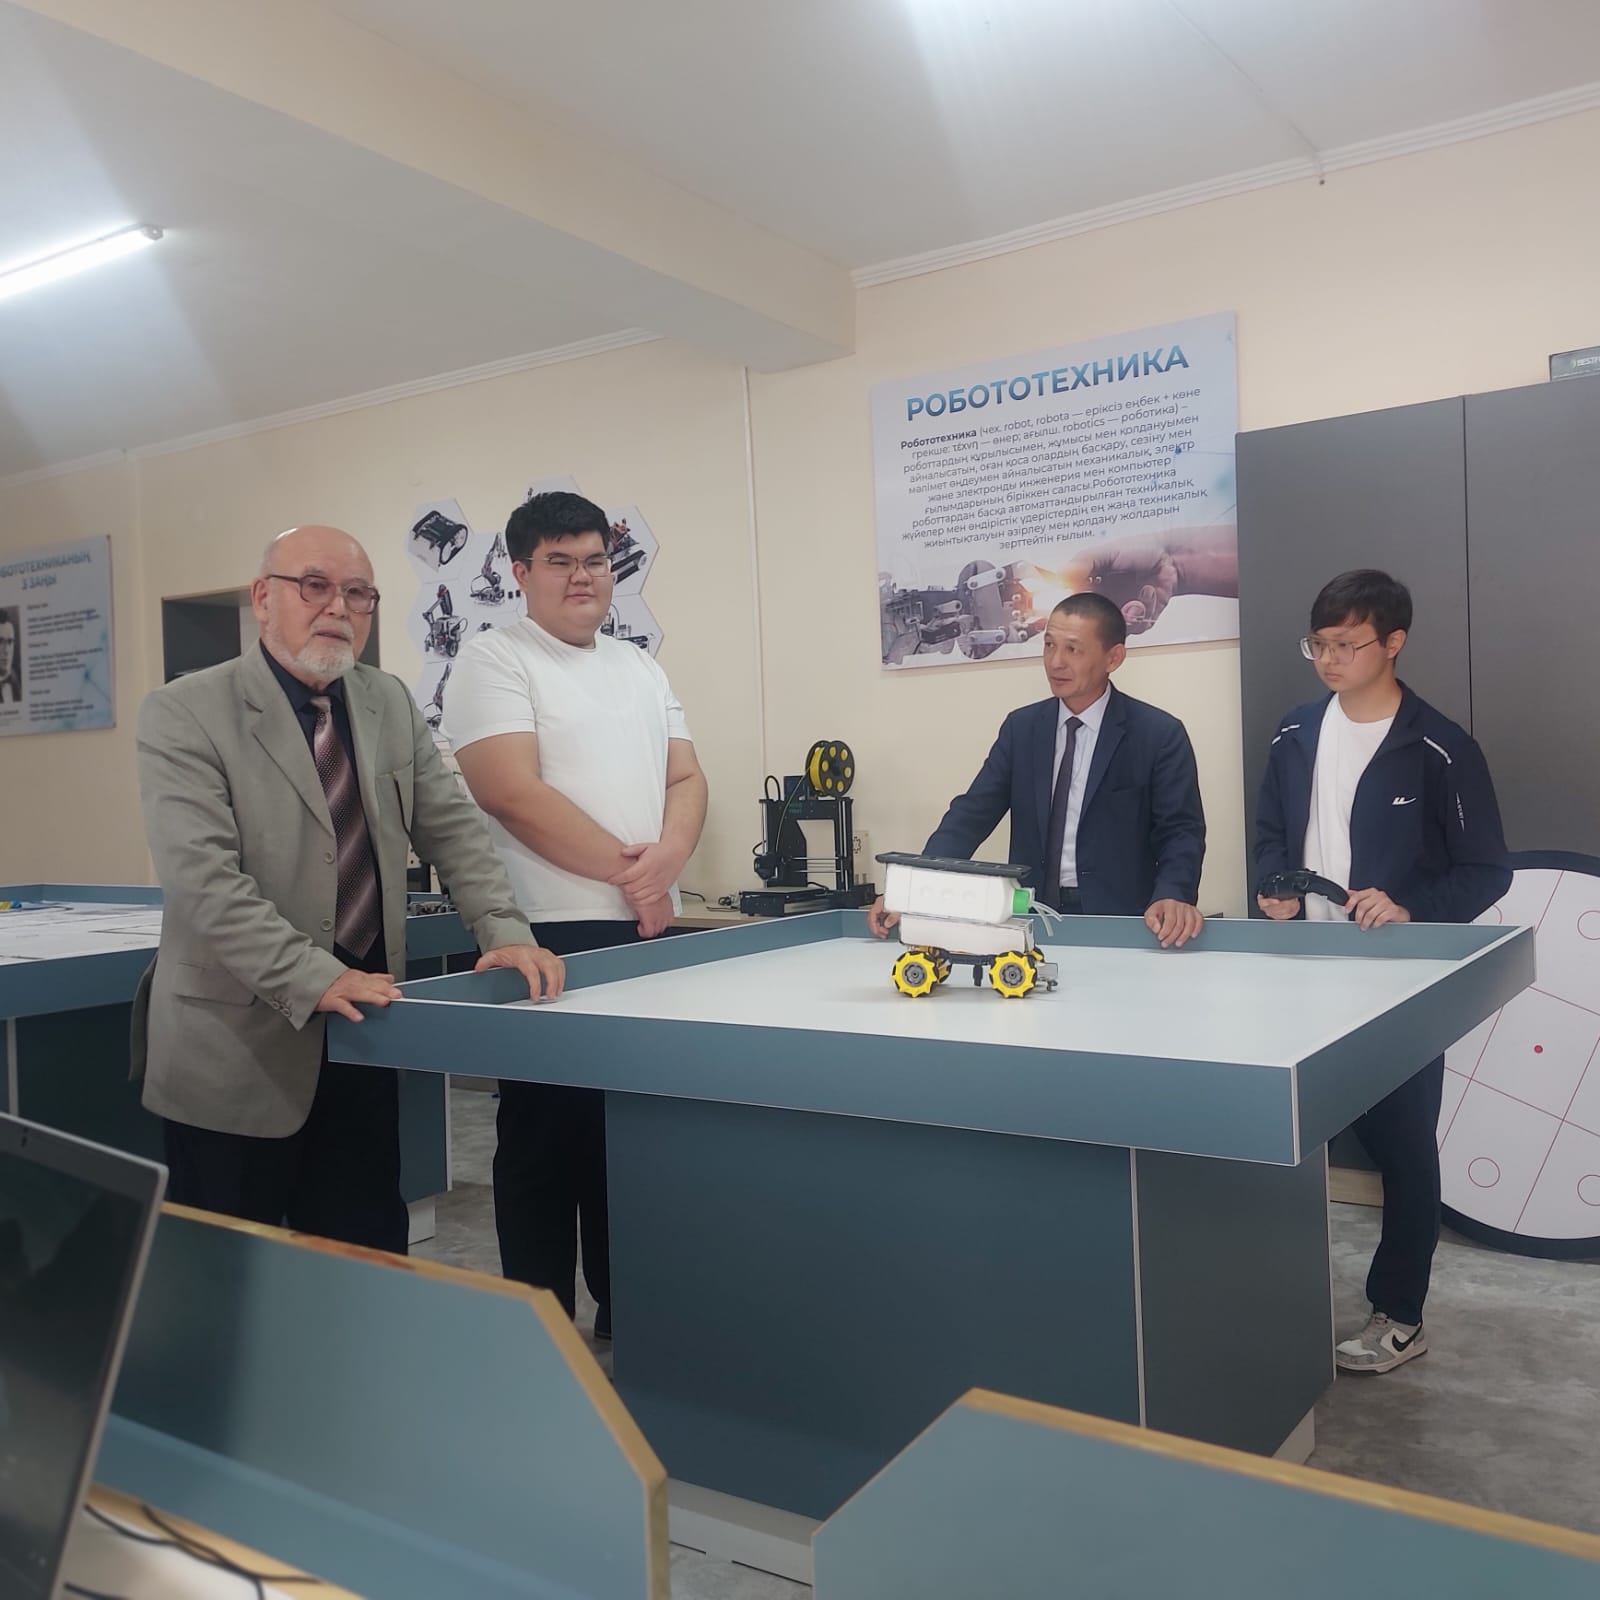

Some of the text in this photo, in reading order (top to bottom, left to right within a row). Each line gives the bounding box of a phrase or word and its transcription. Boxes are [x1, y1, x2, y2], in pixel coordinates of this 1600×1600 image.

[907, 344, 1190, 421] РОБОТОТЕХНИКА
[901, 429, 977, 450] Робототехника
[1004, 418, 1034, 432] robot,
[1036, 411, 1069, 426] robota
[1085, 402, 1123, 420] еріксіз
[1125, 393, 1161, 410] еңбек
[1172, 388, 1201, 401] көне
[993, 431, 1022, 446] өнер;
[1023, 426, 1059, 440] ағылш.
[1062, 415, 1105, 433] robotics
[1121, 403, 1179, 424] роботика)
[903, 456, 968, 475] роботтардың
[1095, 427, 1117, 441] мен
[1120, 415, 1199, 437] қолдануымен
[909, 466, 978, 483] айналысатын,
[980, 461, 1003, 472] оған
[1006, 455, 1029, 469] қоса
[1031, 448, 1079, 465] олардың
[1131, 432, 1166, 447] сезіну
[1169, 428, 1192, 441] мен
[1002, 459, 1073, 480] айналысатын
[1154, 440, 1195, 455] электр
[956, 482, 1017, 499] электронды
[1019, 471, 1081, 489] инженерия
[1083, 467, 1105, 479] мен
[1108, 455, 1172, 474] компьютер
[1006, 489, 1050, 503] біріккен
[912, 512, 975, 530] роботтардан
[1008, 490, 1123, 513] автоматтандырылған
[1125, 478, 1195, 496] техникалық
[946, 522, 967, 534] мен
[968, 515, 1018, 531] өндірістік
[1090, 504, 1105, 514] ең
[1107, 498, 1136, 511] жаңа
[1138, 488, 1209, 505] техникалық
[1049, 518, 1070, 530] мен
[1072, 514, 1118, 530] қолдану
[1120, 504, 1180, 521] жолдарын
[1056, 528, 1095, 542] ғылым.
